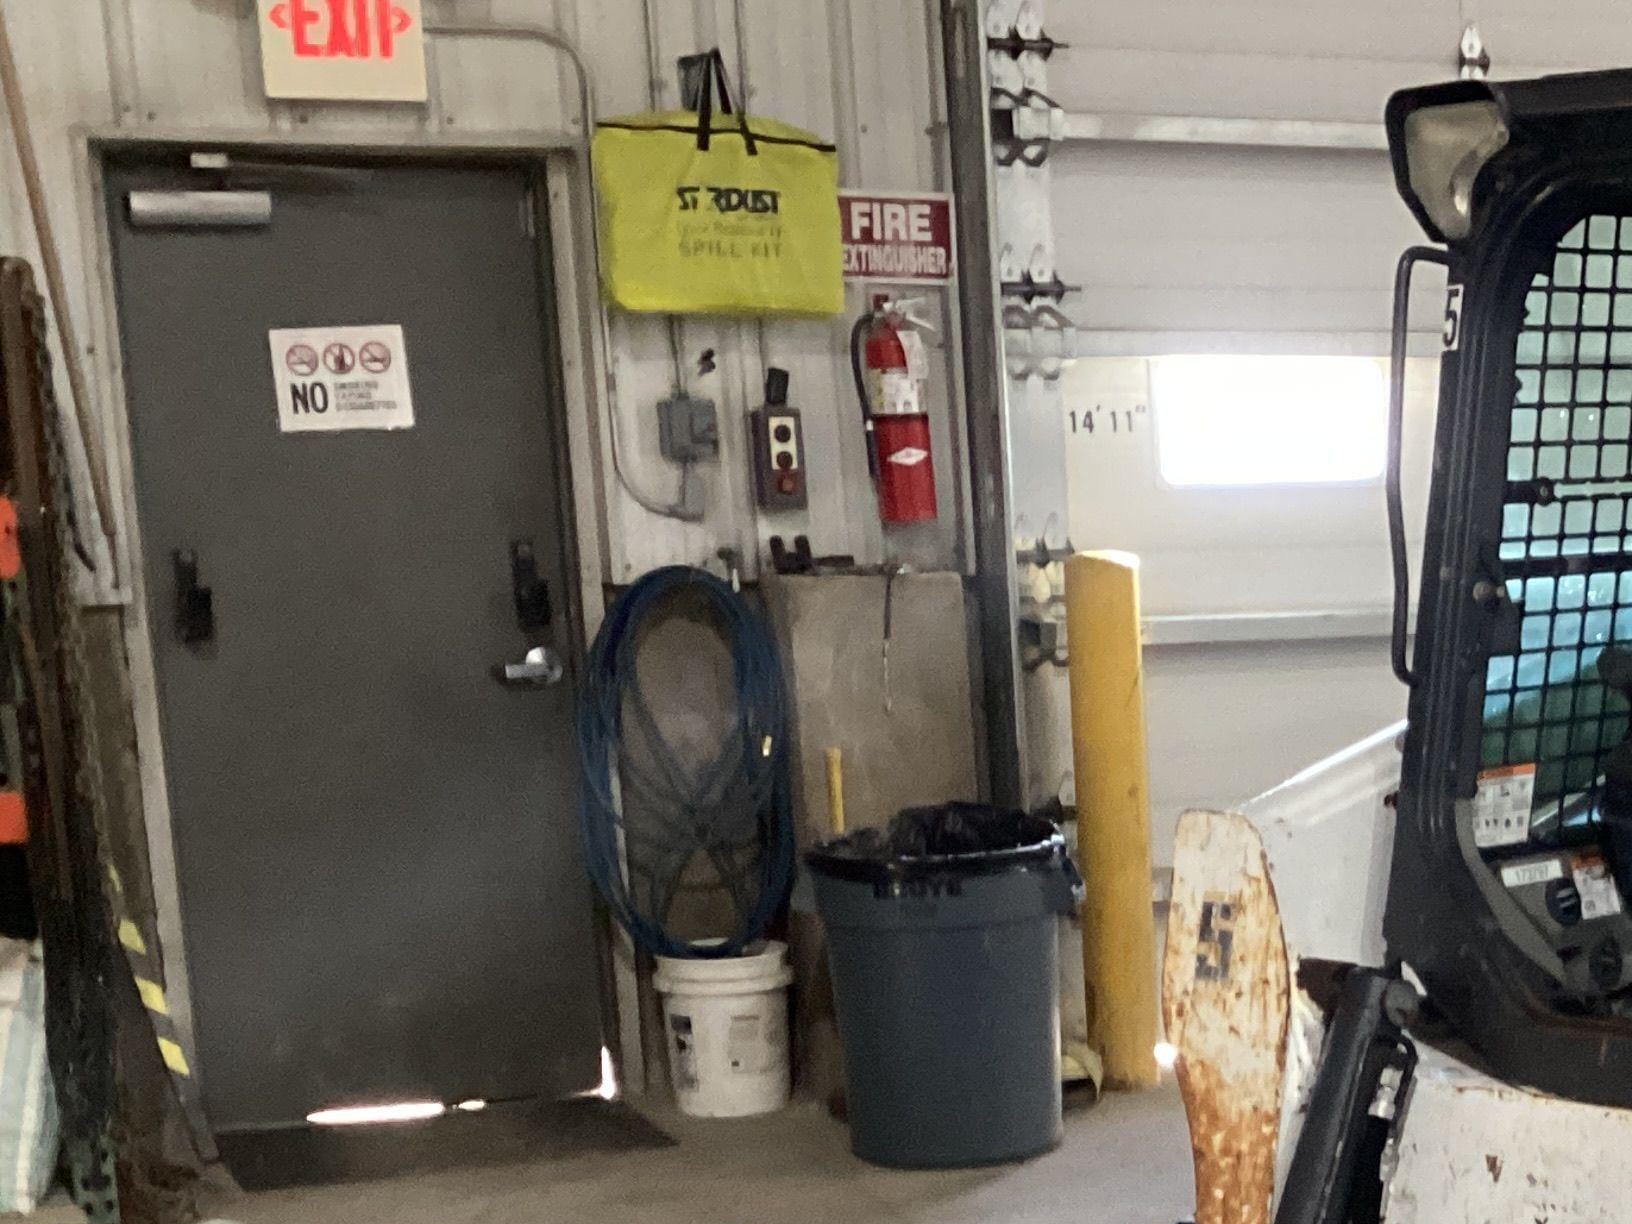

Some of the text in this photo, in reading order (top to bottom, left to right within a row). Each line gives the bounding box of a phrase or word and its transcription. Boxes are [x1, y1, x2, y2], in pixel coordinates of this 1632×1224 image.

[850, 201, 932, 242] FIRE
[1443, 288, 1460, 348] 5
[290, 381, 329, 414] NO
